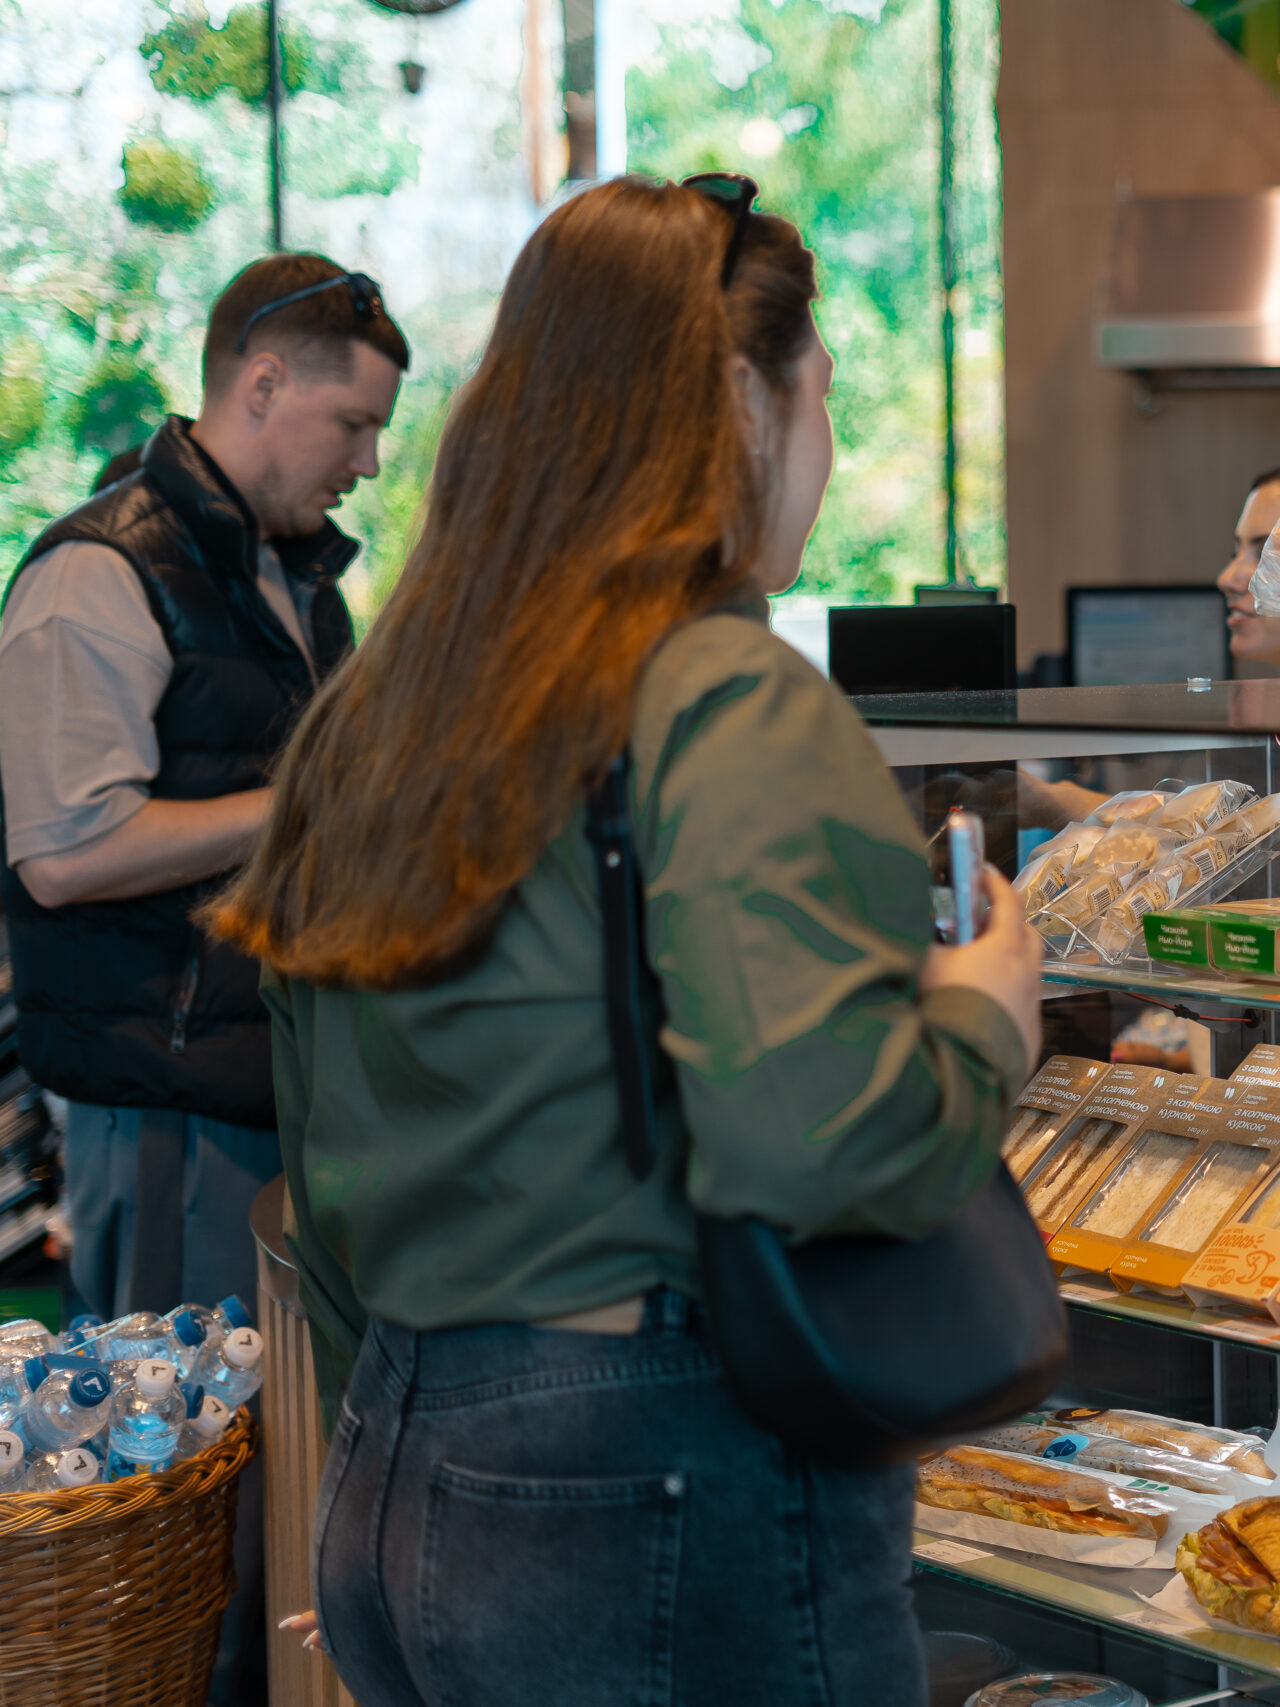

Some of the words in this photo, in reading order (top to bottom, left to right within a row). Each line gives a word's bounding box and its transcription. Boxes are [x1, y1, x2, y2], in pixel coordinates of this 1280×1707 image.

[1158, 935, 1193, 948] Нью-Йорк
[1248, 1065, 1280, 1076] салямі
[1043, 1076, 1073, 1086] салямі
[1037, 1086, 1081, 1102] копченою
[1106, 1086, 1139, 1096] салямі
[1100, 1096, 1149, 1113] копченою
[1166, 1097, 1172, 1105] з
[1172, 1098, 1223, 1115] копченою
[1083, 1105, 1117, 1117] куркою
[1158, 1108, 1196, 1122] куркою
[1234, 1108, 1241, 1116] з
[1225, 1119, 1267, 1132] куркою
[1052, 1246, 1067, 1254] курка
[1056, 1240, 1078, 1249] копчена
[1124, 1255, 1148, 1263] копчена
